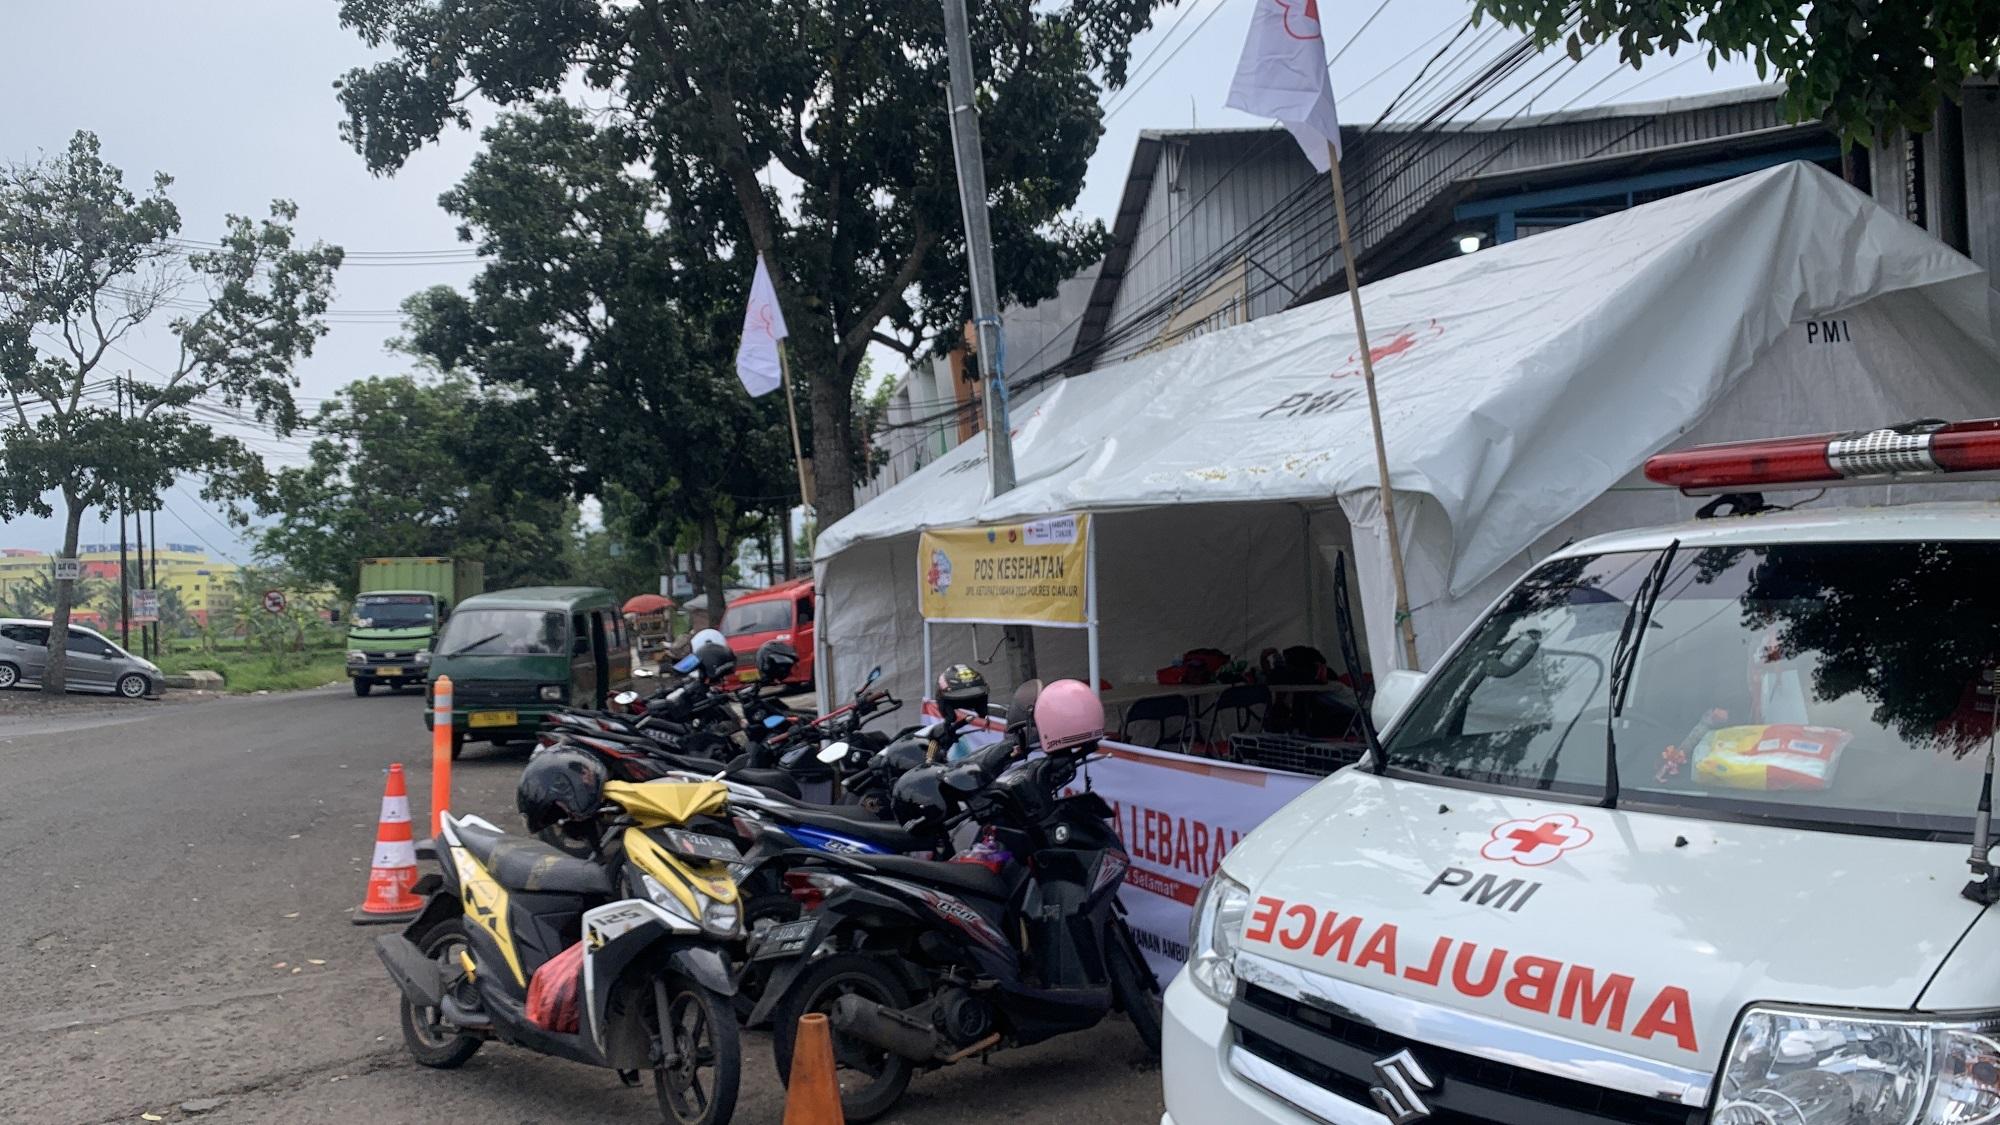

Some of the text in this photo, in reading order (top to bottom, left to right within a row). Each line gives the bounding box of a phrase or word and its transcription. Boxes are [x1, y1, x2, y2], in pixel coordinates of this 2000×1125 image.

[1807, 320, 1851, 344] PMI
[1259, 387, 1361, 419] PMI
[974, 555, 1065, 581] POS KESEHATAN
[1112, 800, 1124, 845] A
[1422, 867, 1543, 913] PMI
[594, 909, 642, 926] 125
[1162, 937, 1190, 964] AMBU
